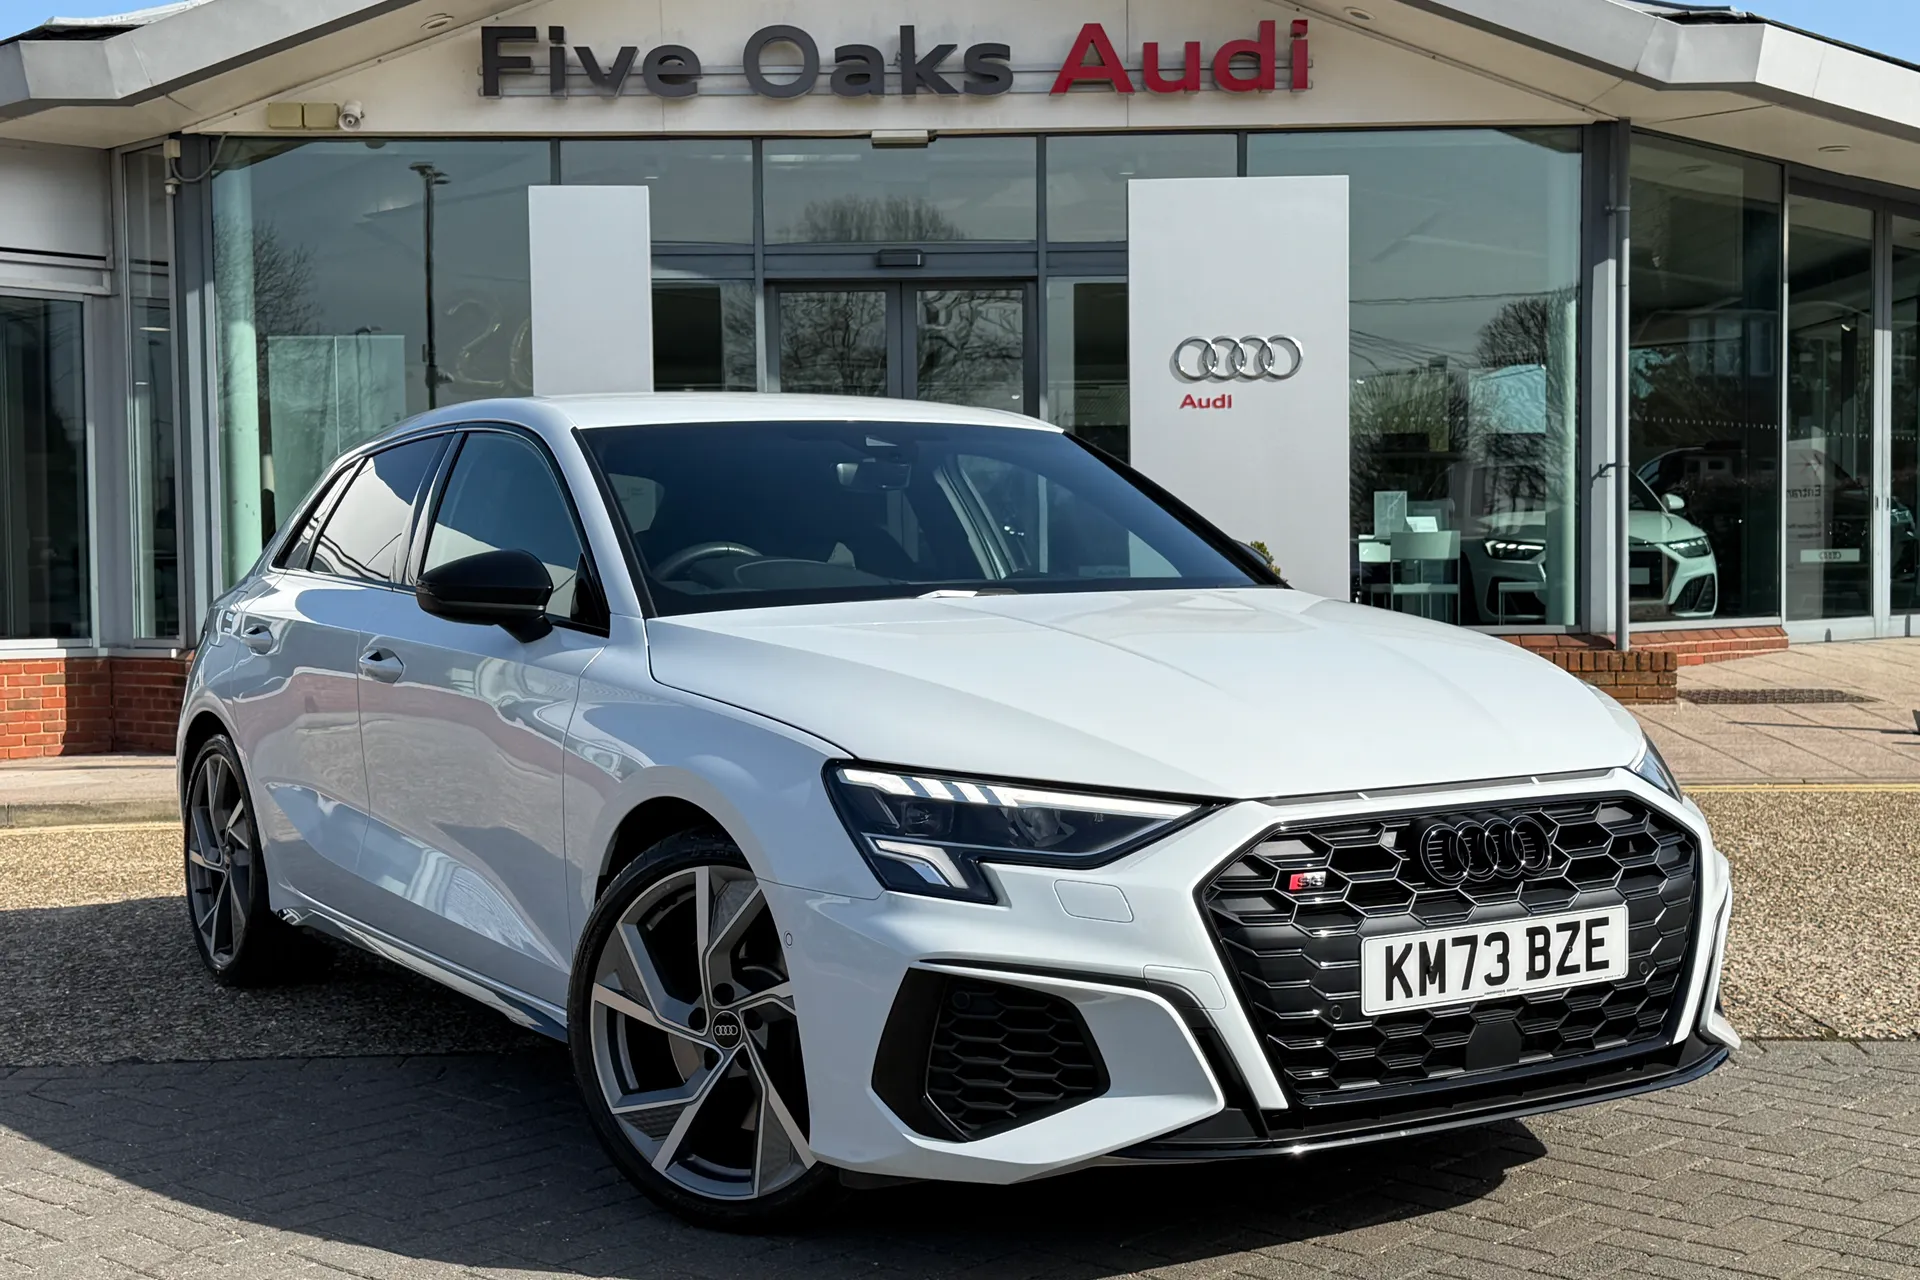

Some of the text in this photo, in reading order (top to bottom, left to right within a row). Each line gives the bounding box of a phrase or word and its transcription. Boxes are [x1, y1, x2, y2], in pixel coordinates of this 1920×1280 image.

[481, 19, 1309, 99] Five Oaks Audi
[1179, 393, 1233, 409] Audi
[1385, 916, 1610, 1002] KM73 BZE
